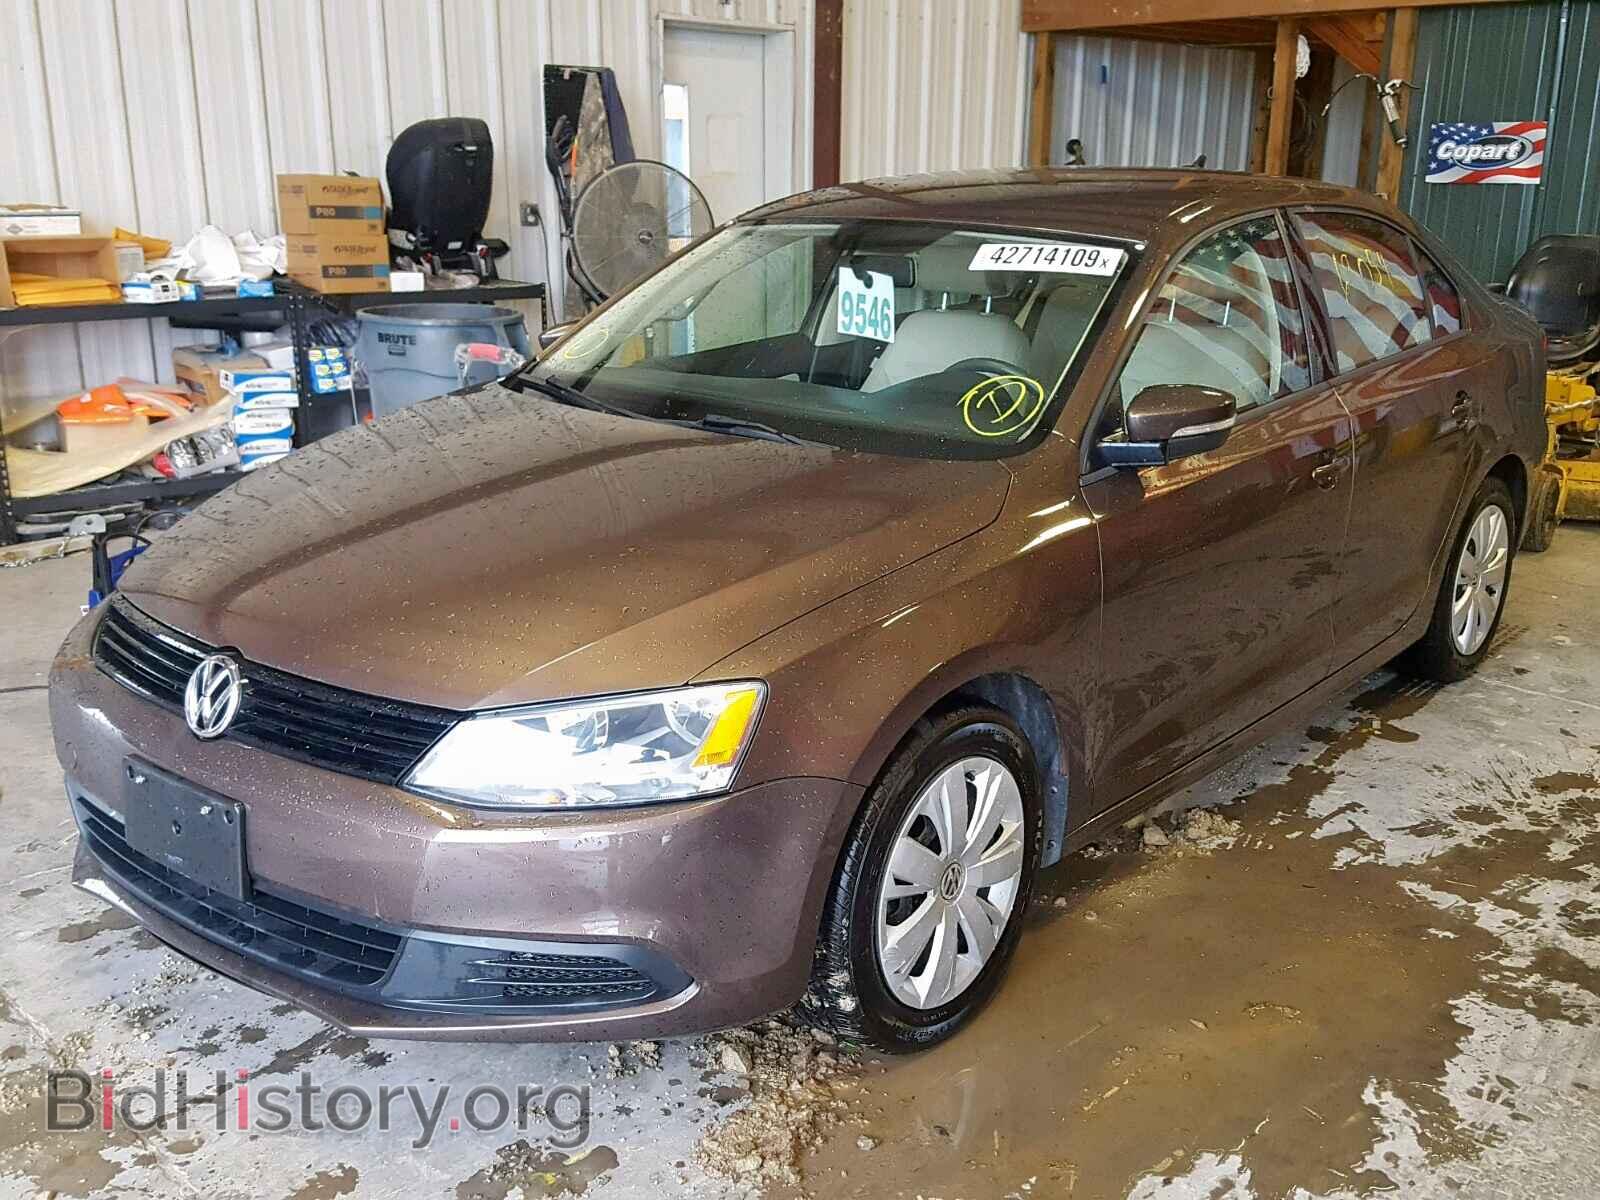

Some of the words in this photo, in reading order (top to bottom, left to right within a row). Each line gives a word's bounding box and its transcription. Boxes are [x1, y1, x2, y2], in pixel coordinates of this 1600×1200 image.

[1437, 139, 1522, 164] Copart
[840, 290, 892, 340] 9546
[378, 332, 417, 346] BRUTE
